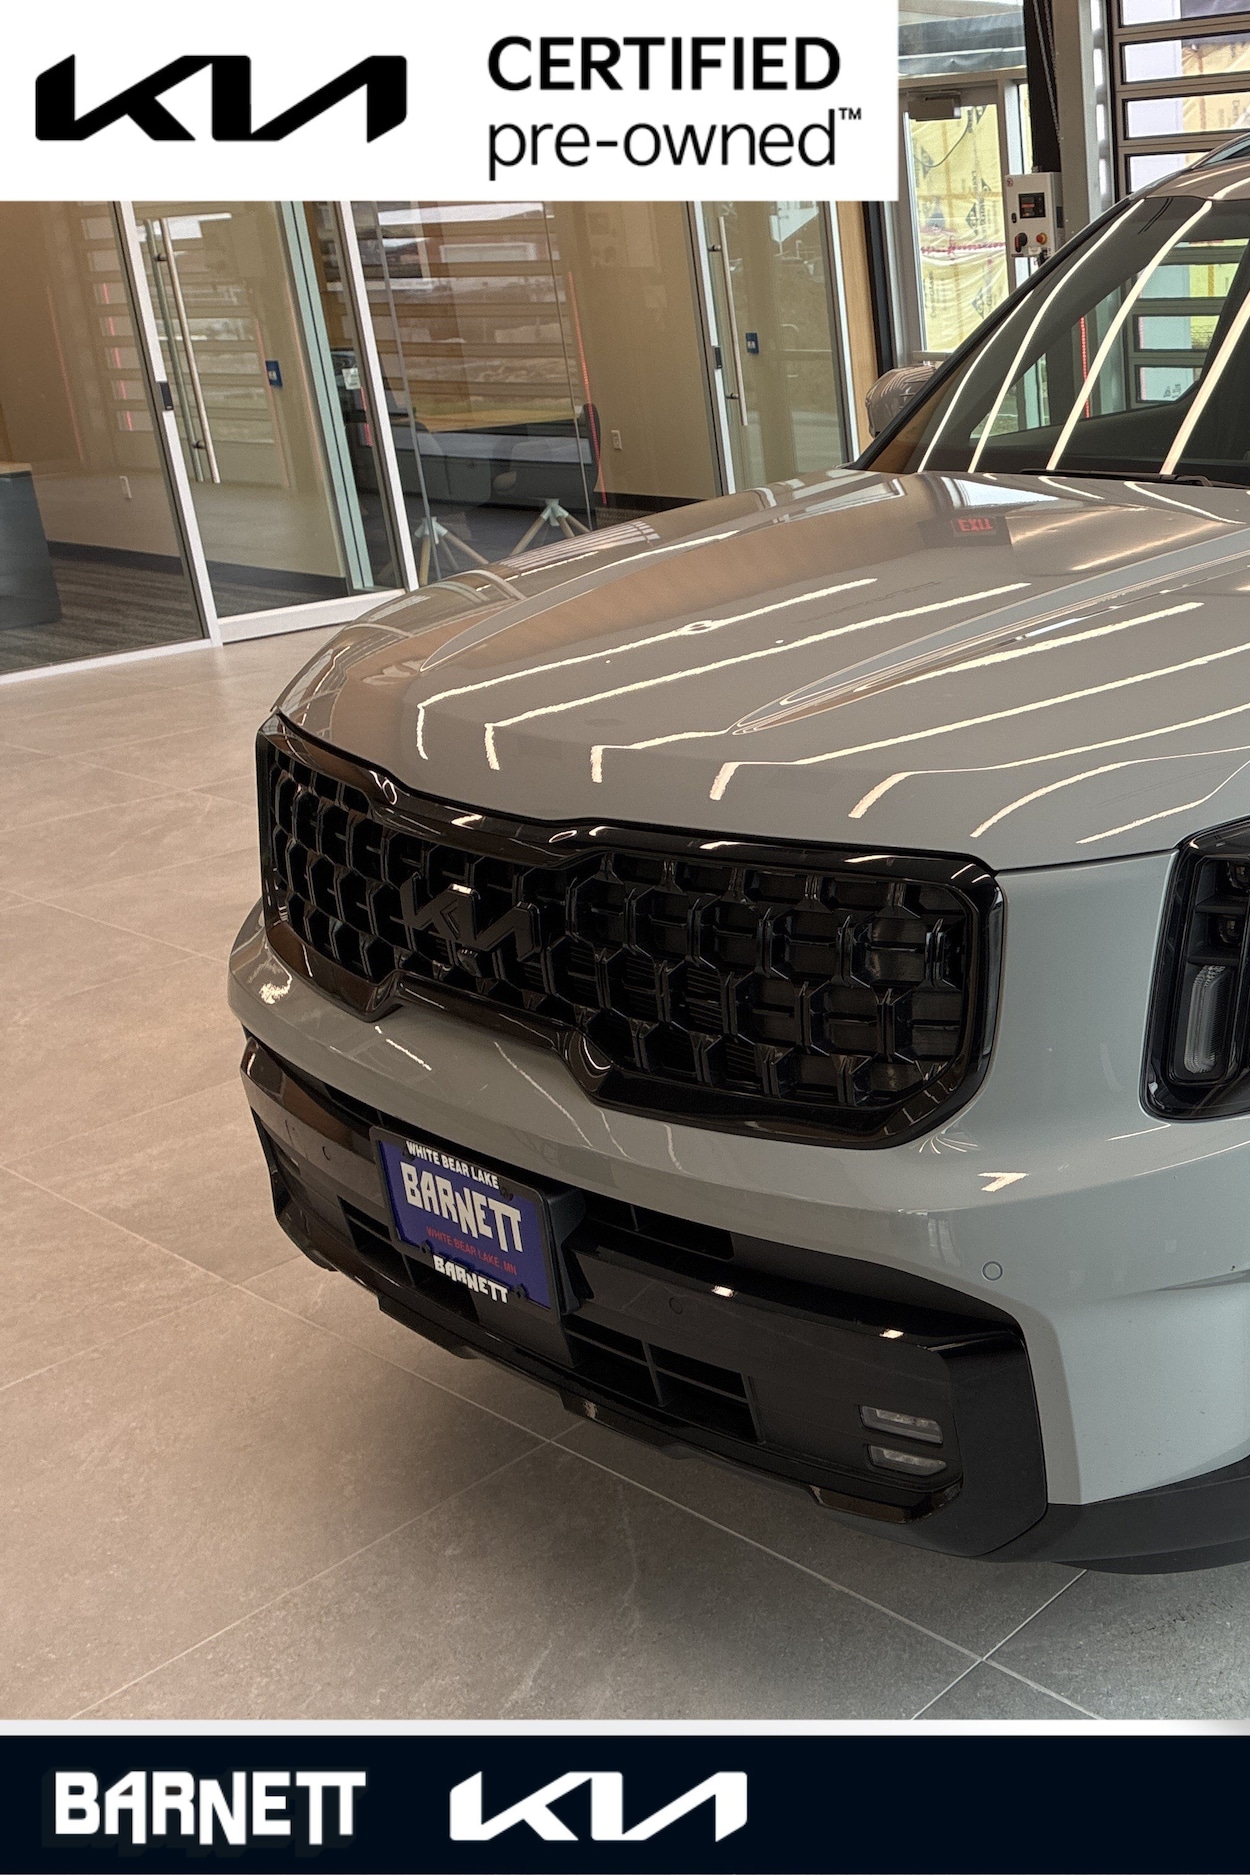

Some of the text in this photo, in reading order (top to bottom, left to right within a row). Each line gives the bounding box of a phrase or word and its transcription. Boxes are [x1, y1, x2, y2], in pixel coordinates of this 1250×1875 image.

[400, 871, 543, 962] KIA
[406, 1140, 500, 1190] WHITE BEAR LAKE
[400, 1161, 524, 1253] BARNETT
[426, 1226, 453, 1246] WHITE
[453, 1238, 477, 1256] BEAR
[503, 1260, 518, 1276] MN
[433, 1254, 508, 1304] BARNETT
